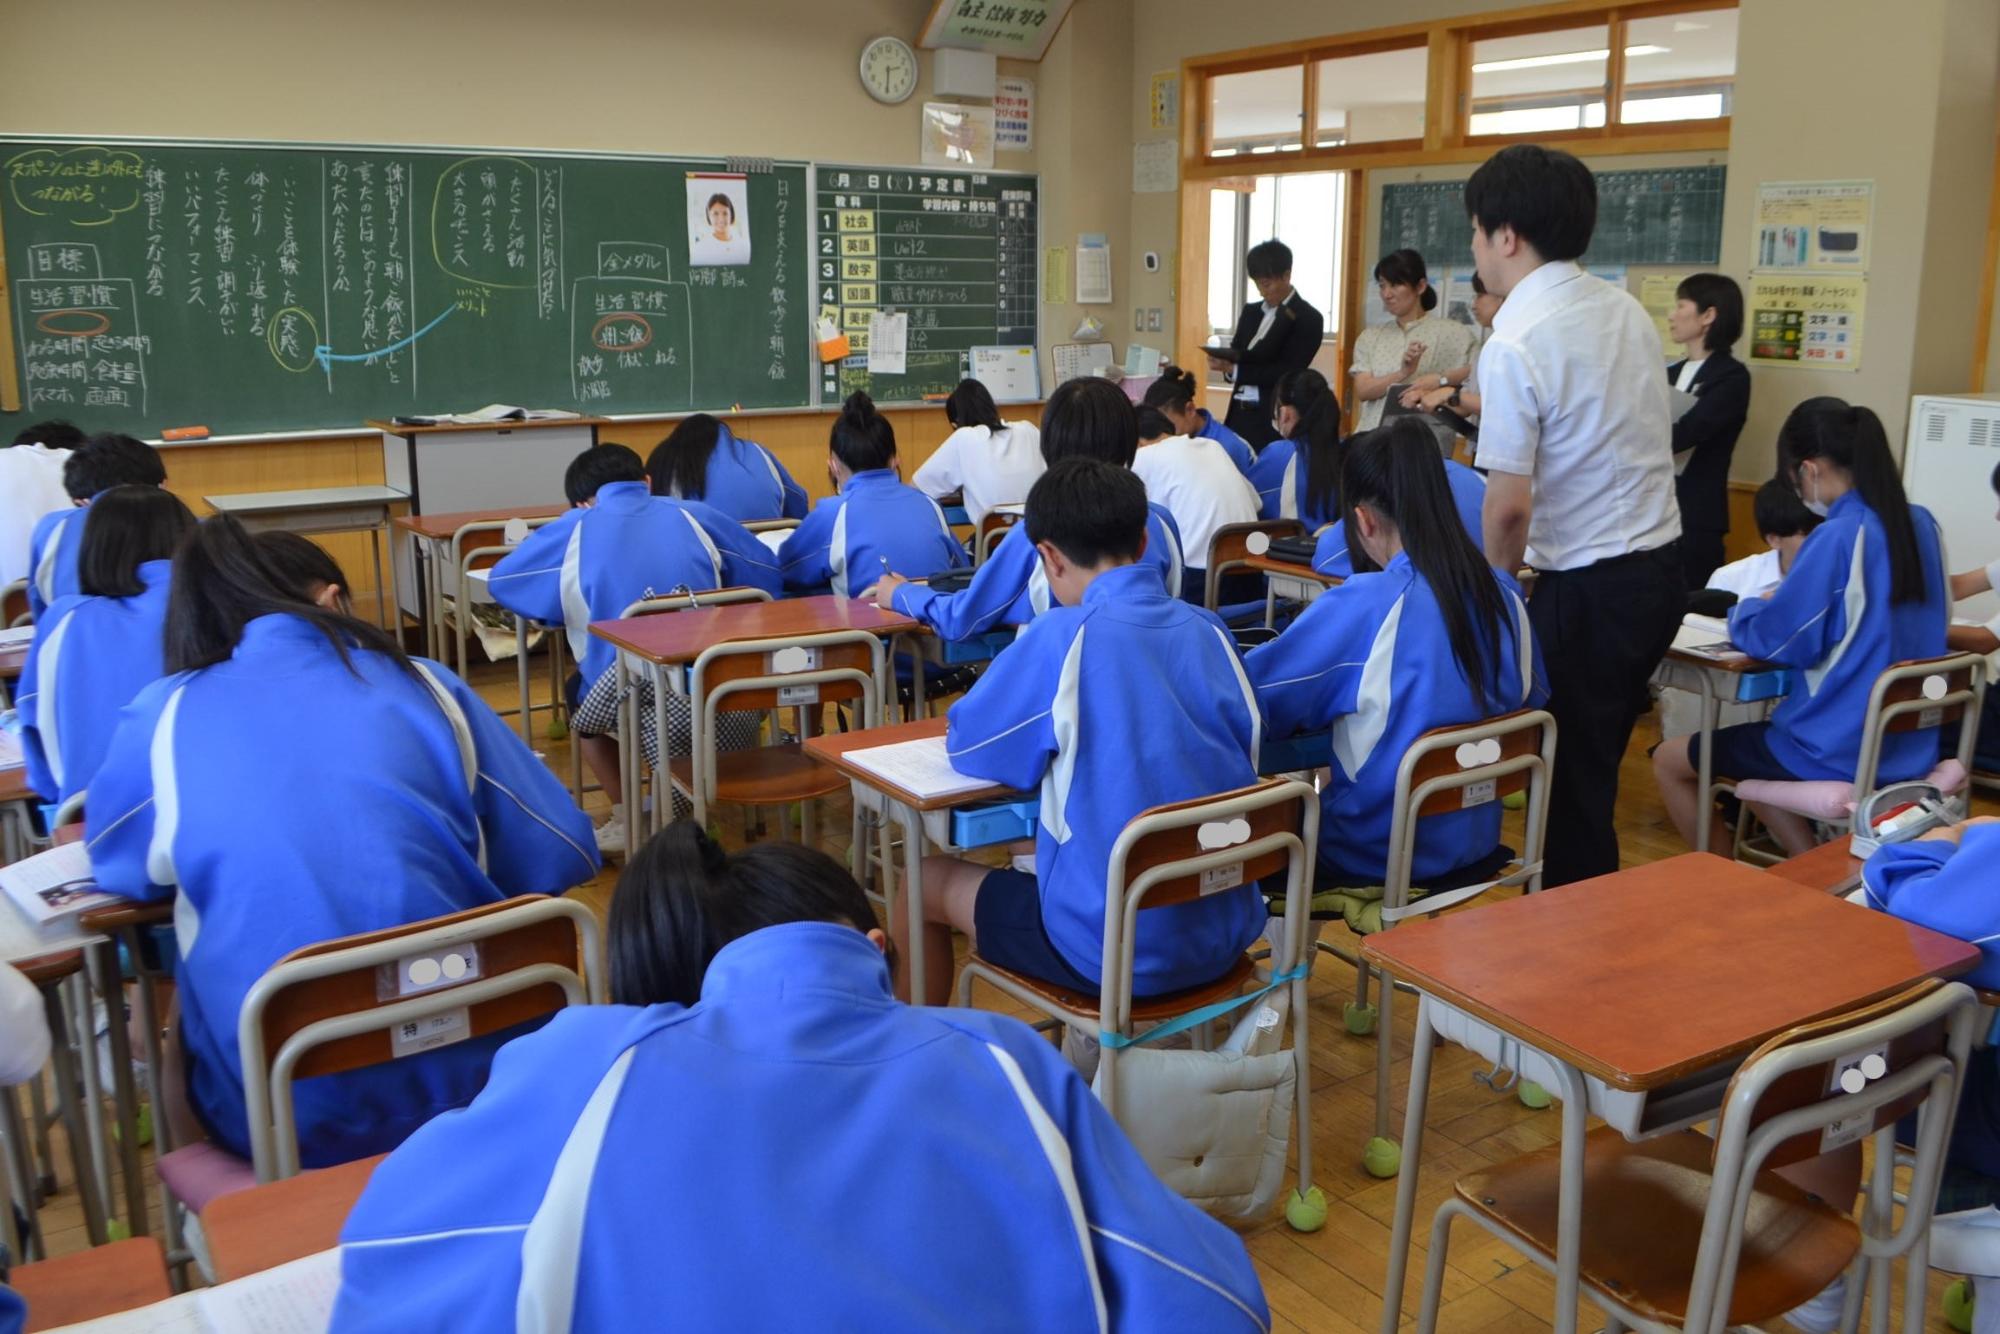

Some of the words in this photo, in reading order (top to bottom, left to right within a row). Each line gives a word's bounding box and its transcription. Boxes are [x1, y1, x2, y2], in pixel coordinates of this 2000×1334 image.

[835, 195, 861, 208] 教科
[823, 214, 831, 229] 1
[845, 215, 868, 228] 社会
[822, 239, 833, 254] 2
[846, 239, 870, 254] 英語
[38, 249, 87, 272] 目標
[822, 263, 834, 278] 3
[848, 263, 871, 277] 数学
[823, 288, 834, 302] 4
[848, 288, 871, 301] 国語
